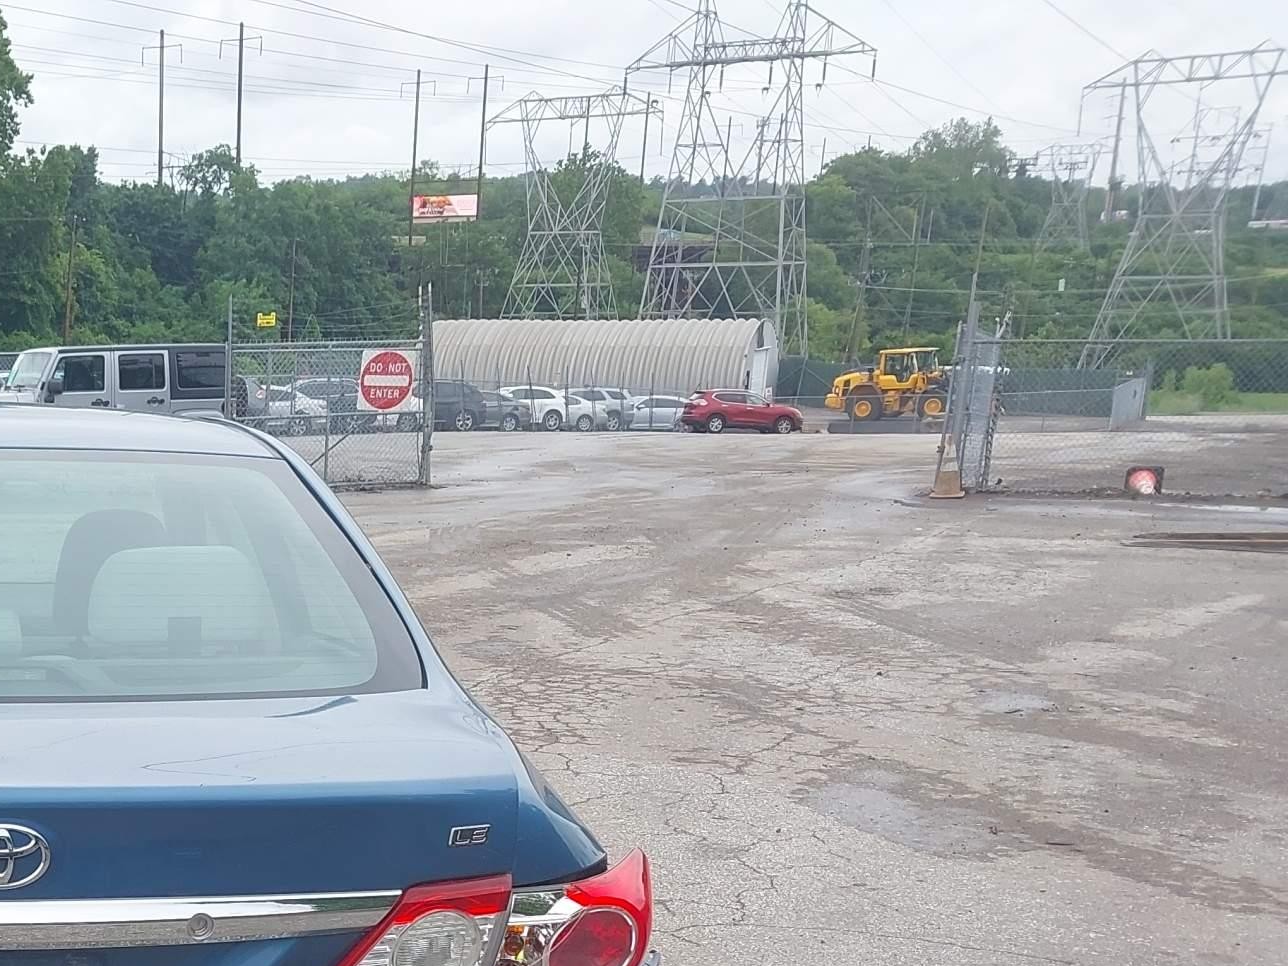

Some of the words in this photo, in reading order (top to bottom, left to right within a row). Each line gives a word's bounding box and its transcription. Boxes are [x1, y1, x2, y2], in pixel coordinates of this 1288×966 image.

[370, 362, 383, 373] DO
[388, 362, 408, 374] NOT
[370, 388, 400, 399] ENTER
[451, 825, 490, 845] LE
